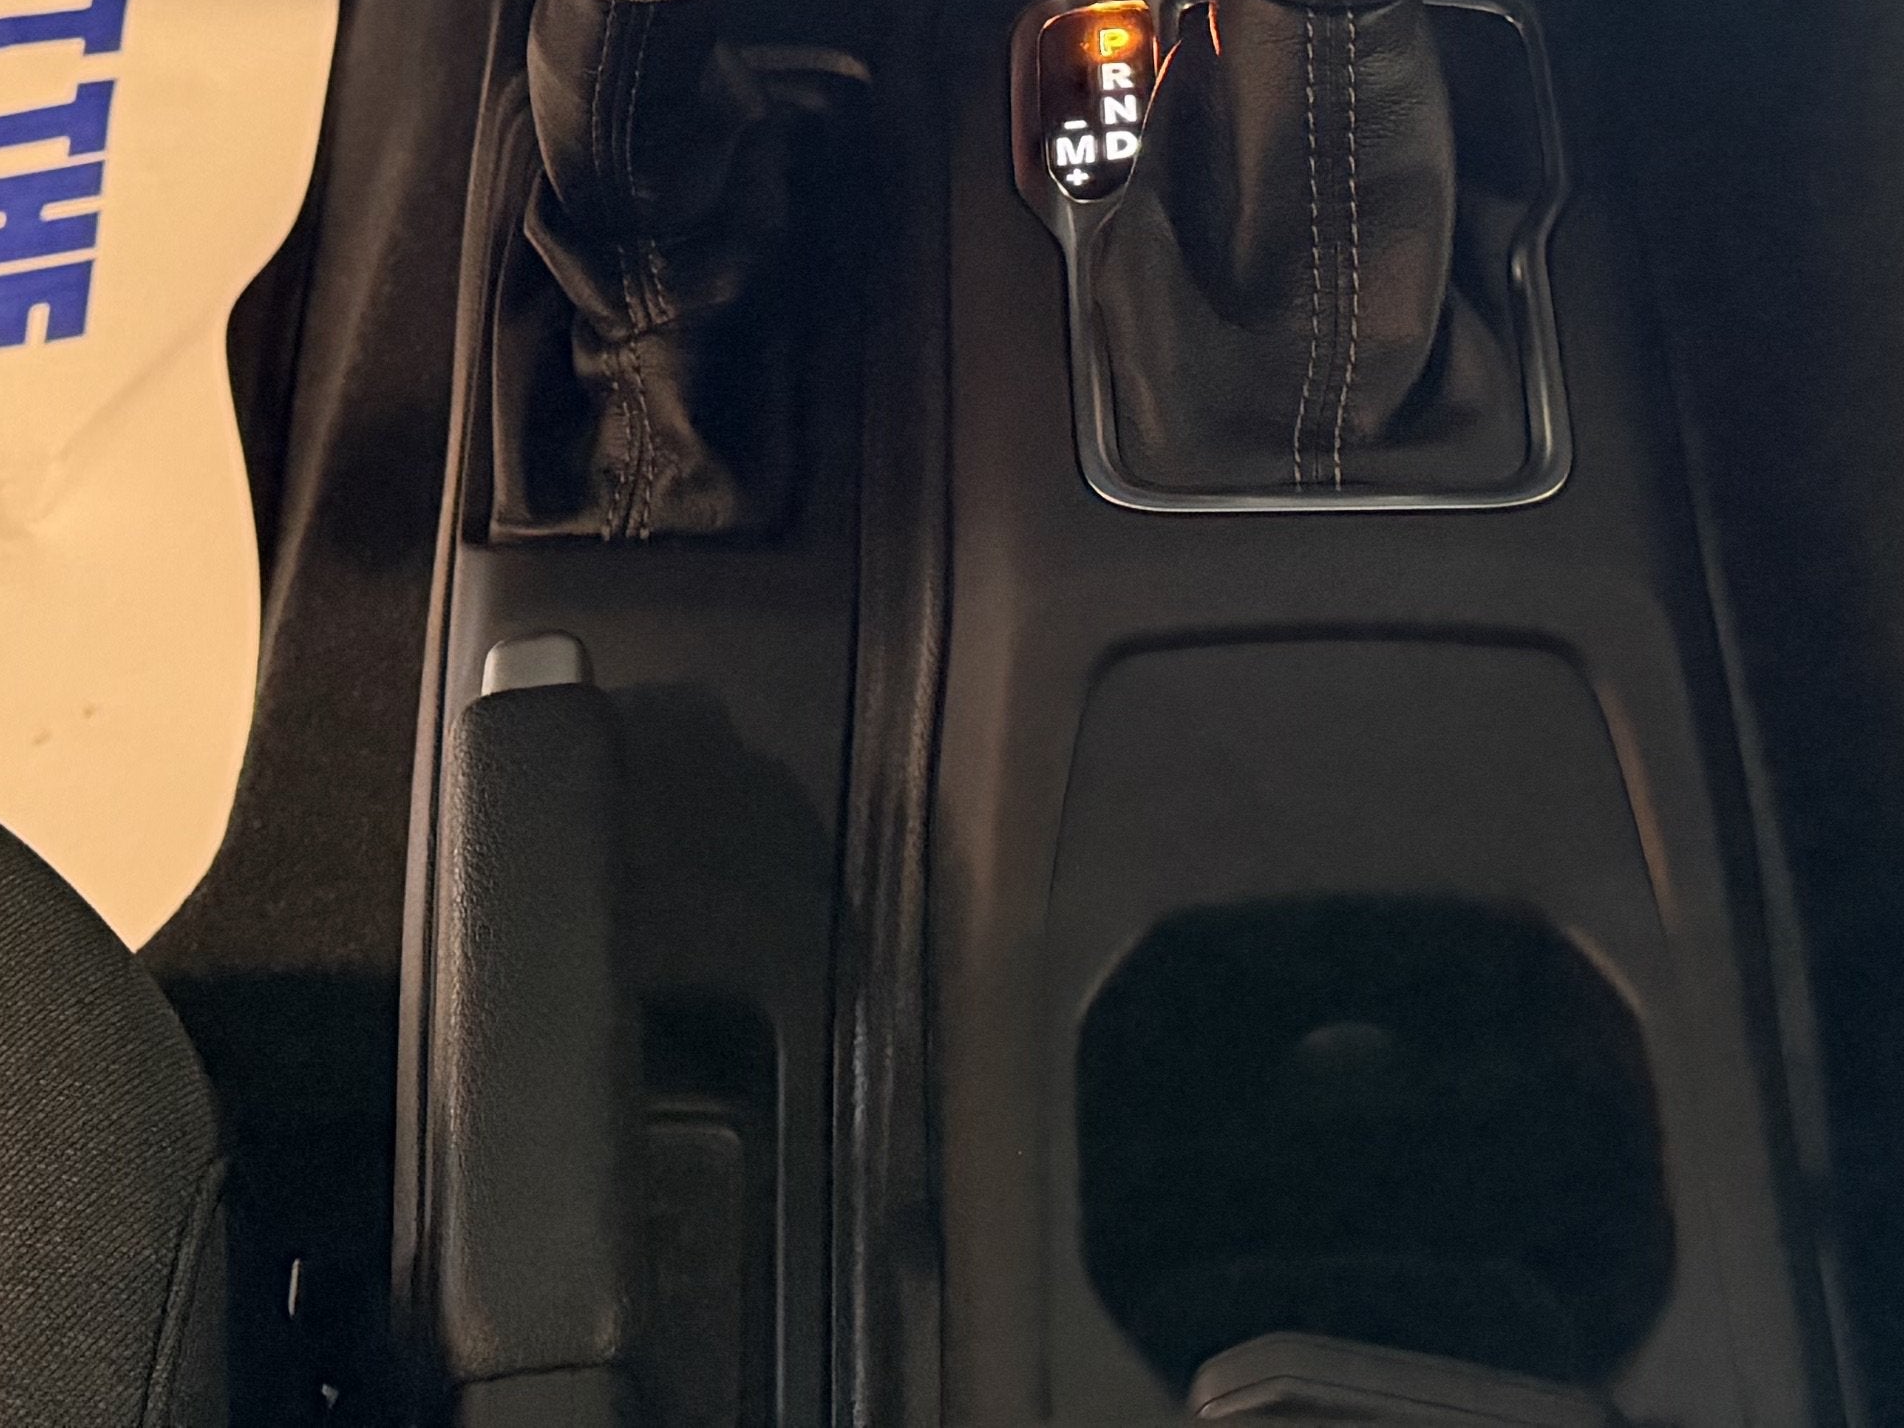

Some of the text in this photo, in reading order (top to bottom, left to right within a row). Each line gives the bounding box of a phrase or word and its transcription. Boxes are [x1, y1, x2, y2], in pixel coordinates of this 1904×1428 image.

[1099, 27, 1129, 57] P
[1101, 62, 1134, 90] R
[1103, 94, 1137, 125] N
[1056, 135, 1096, 166] M
[1106, 131, 1141, 160] D
